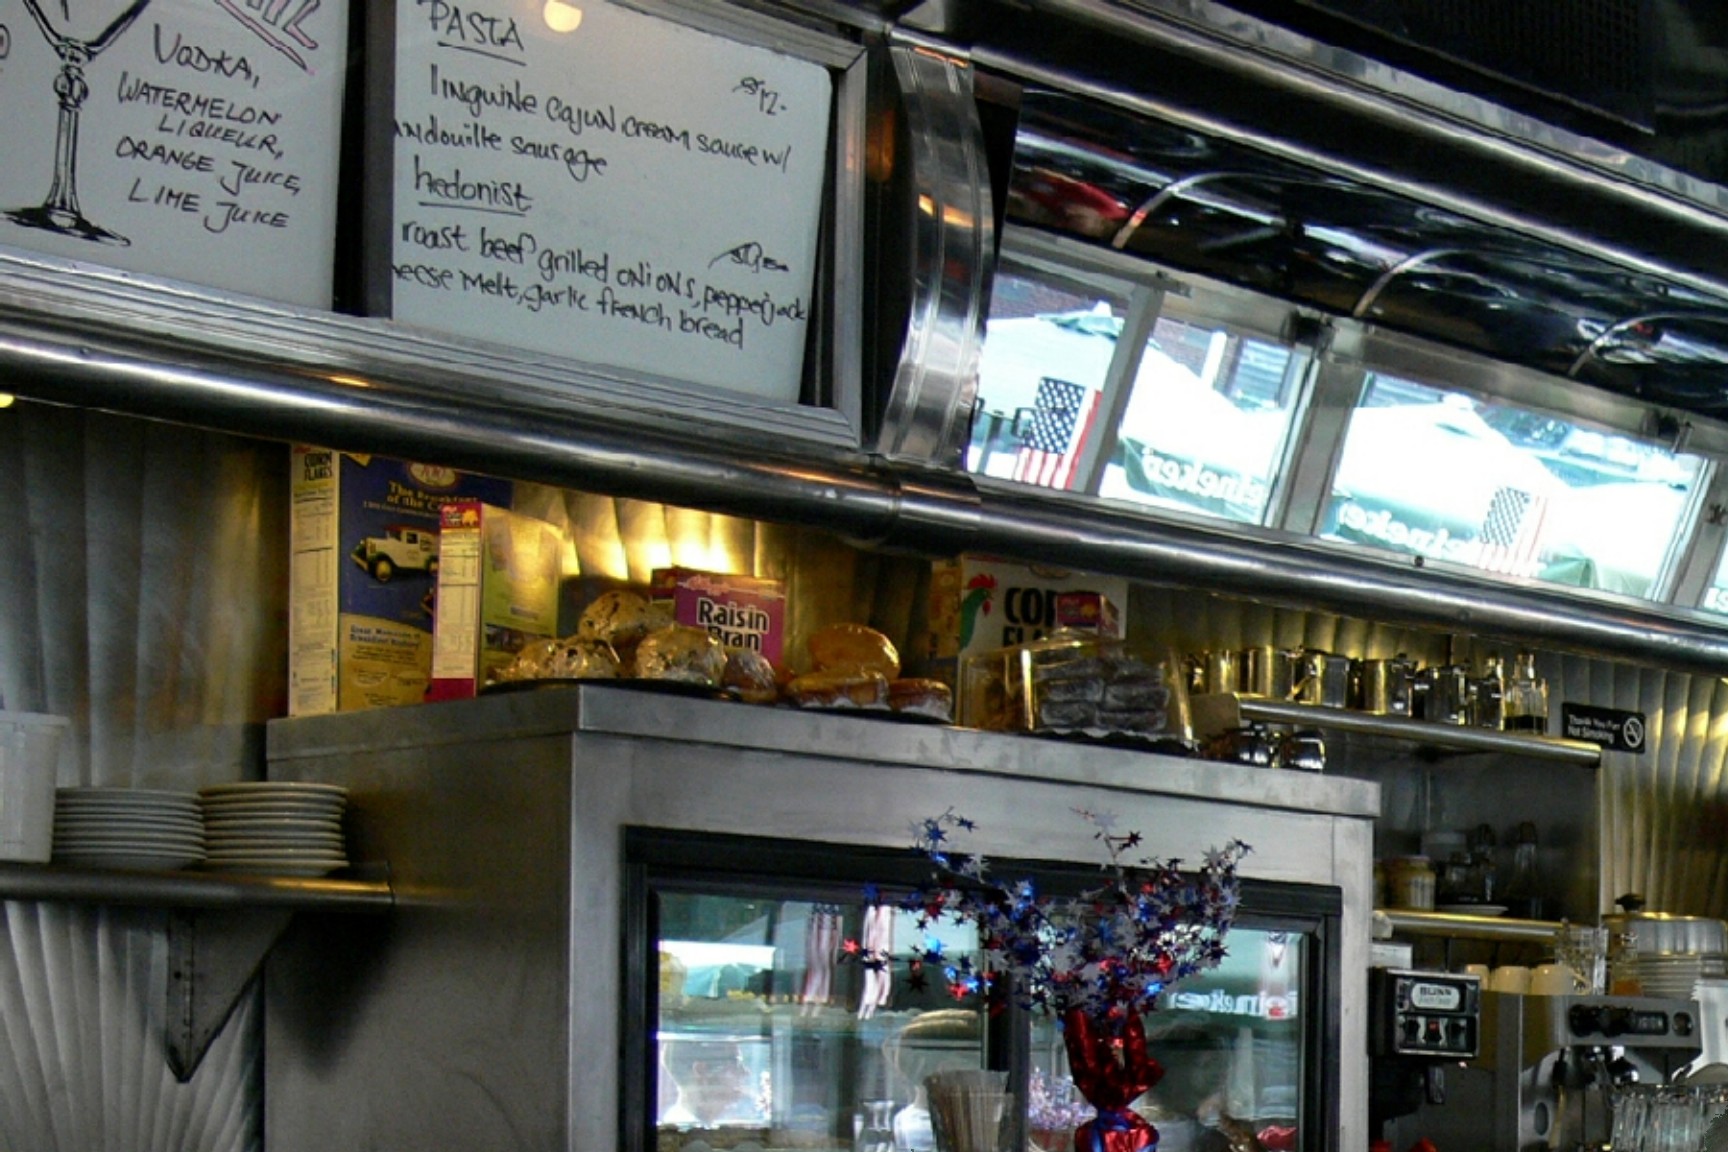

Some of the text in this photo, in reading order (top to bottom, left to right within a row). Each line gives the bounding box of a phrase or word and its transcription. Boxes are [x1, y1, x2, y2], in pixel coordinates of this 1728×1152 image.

[430, 0, 525, 51] PASTA
[117, 70, 284, 126] WATERMELON
[115, 135, 216, 173] ORANGE
[127, 176, 291, 234] LIME JUICE
[401, 220, 470, 251] roast
[678, 308, 744, 351] bread
[697, 598, 769, 634] Raisin
